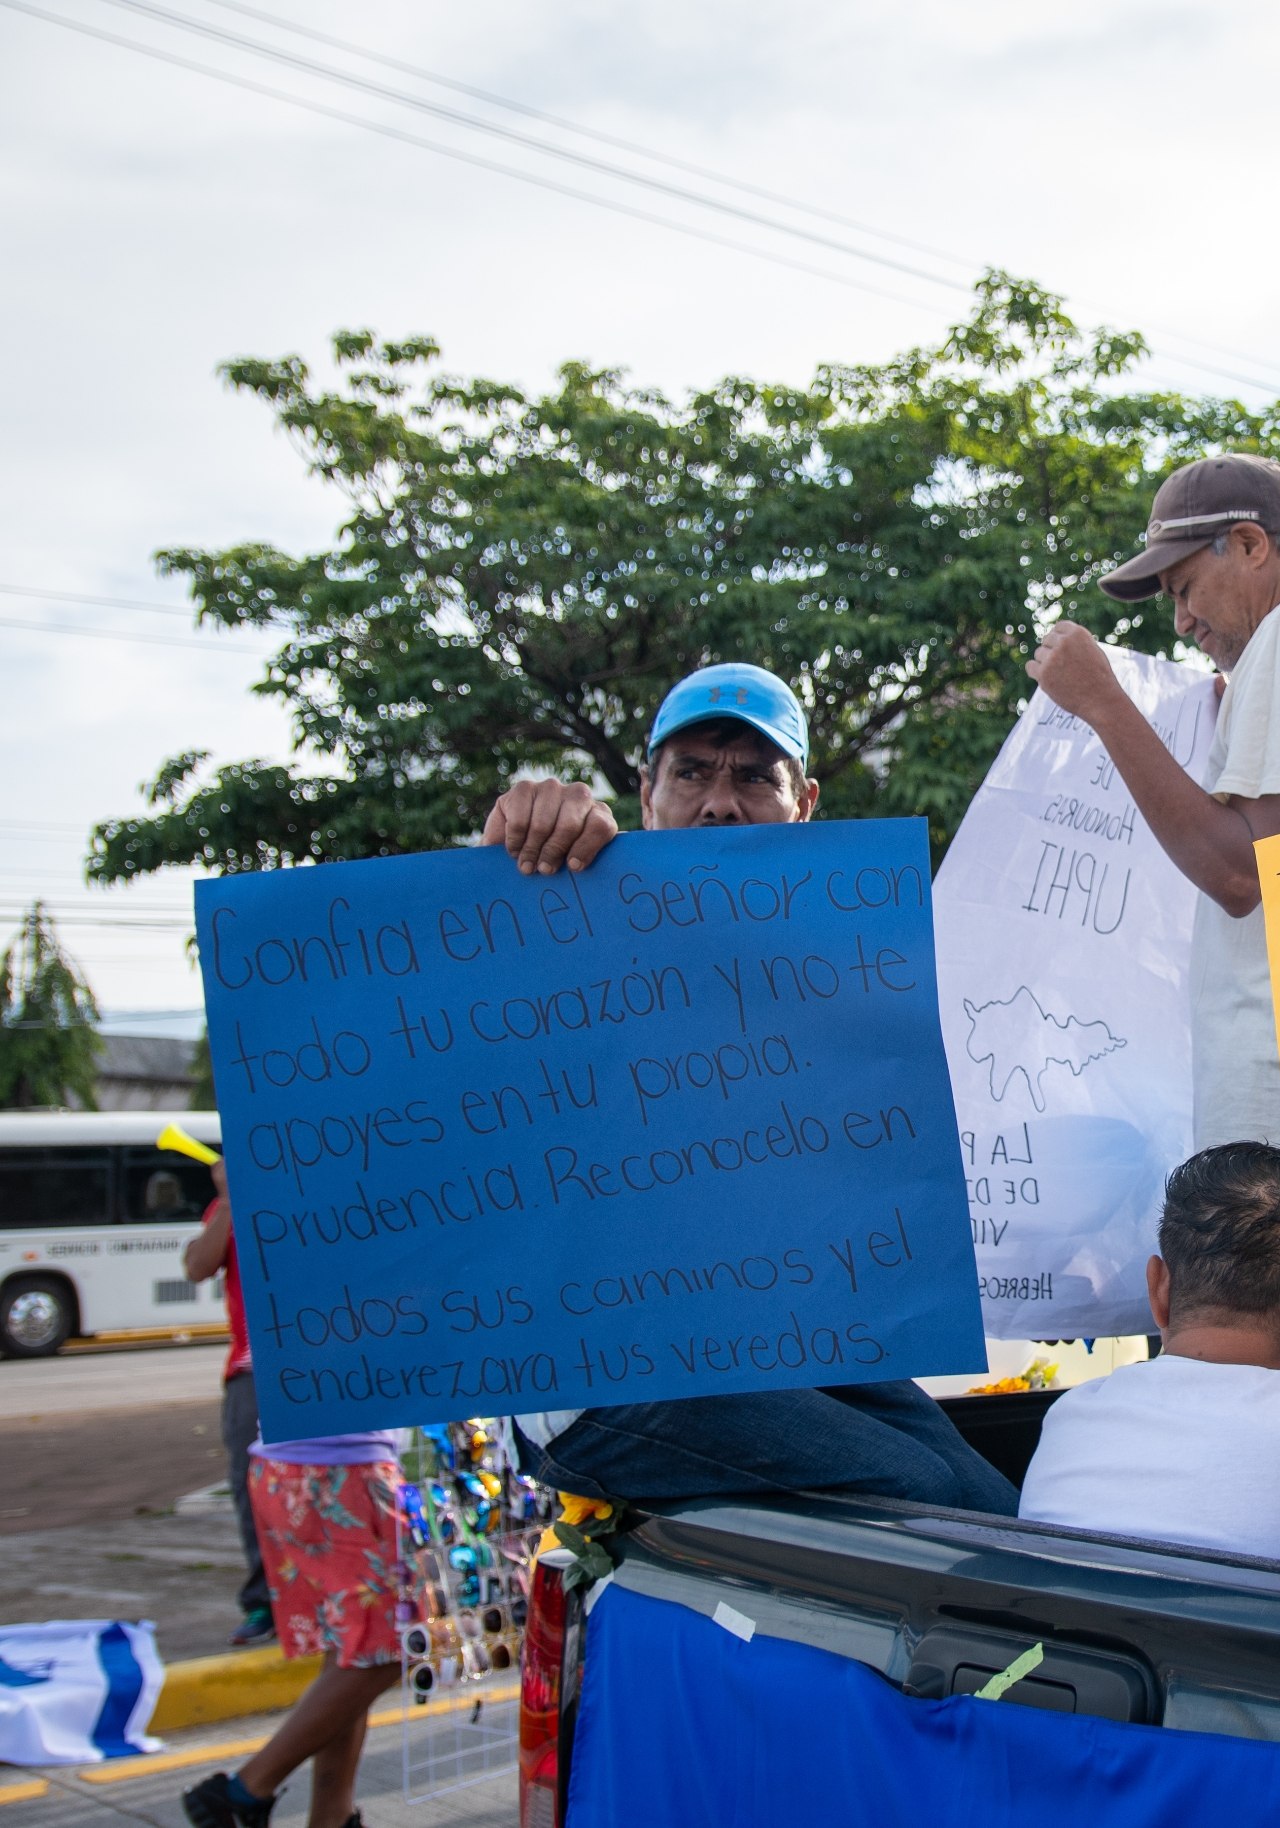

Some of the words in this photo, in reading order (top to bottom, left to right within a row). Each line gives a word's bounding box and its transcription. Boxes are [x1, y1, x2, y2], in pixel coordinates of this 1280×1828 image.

[1228, 510, 1260, 520] NIKE
[212, 897, 420, 990] Confia
[439, 898, 525, 962] en
[540, 870, 594, 944] el
[826, 865, 924, 912] con
[231, 1016, 371, 1094] todo
[389, 995, 454, 1059] tu
[469, 957, 690, 1043] corazón
[760, 954, 840, 1001] no
[849, 934, 917, 993] te
[248, 1100, 445, 1197] apoyes
[461, 1086, 533, 1135] en
[538, 1059, 599, 1115] tu
[629, 1033, 812, 1126] propia.
[251, 1163, 539, 1282] prudencia.
[543, 1100, 829, 1204] Reconocelo
[842, 1105, 916, 1151] en
[264, 1284, 428, 1349] todos
[442, 1285, 534, 1333] sus
[560, 1248, 814, 1316] caminos
[867, 1207, 913, 1268] el
[278, 1354, 559, 1404] enderezara
[573, 1337, 655, 1387] tus
[670, 1311, 891, 1374] veredas.
